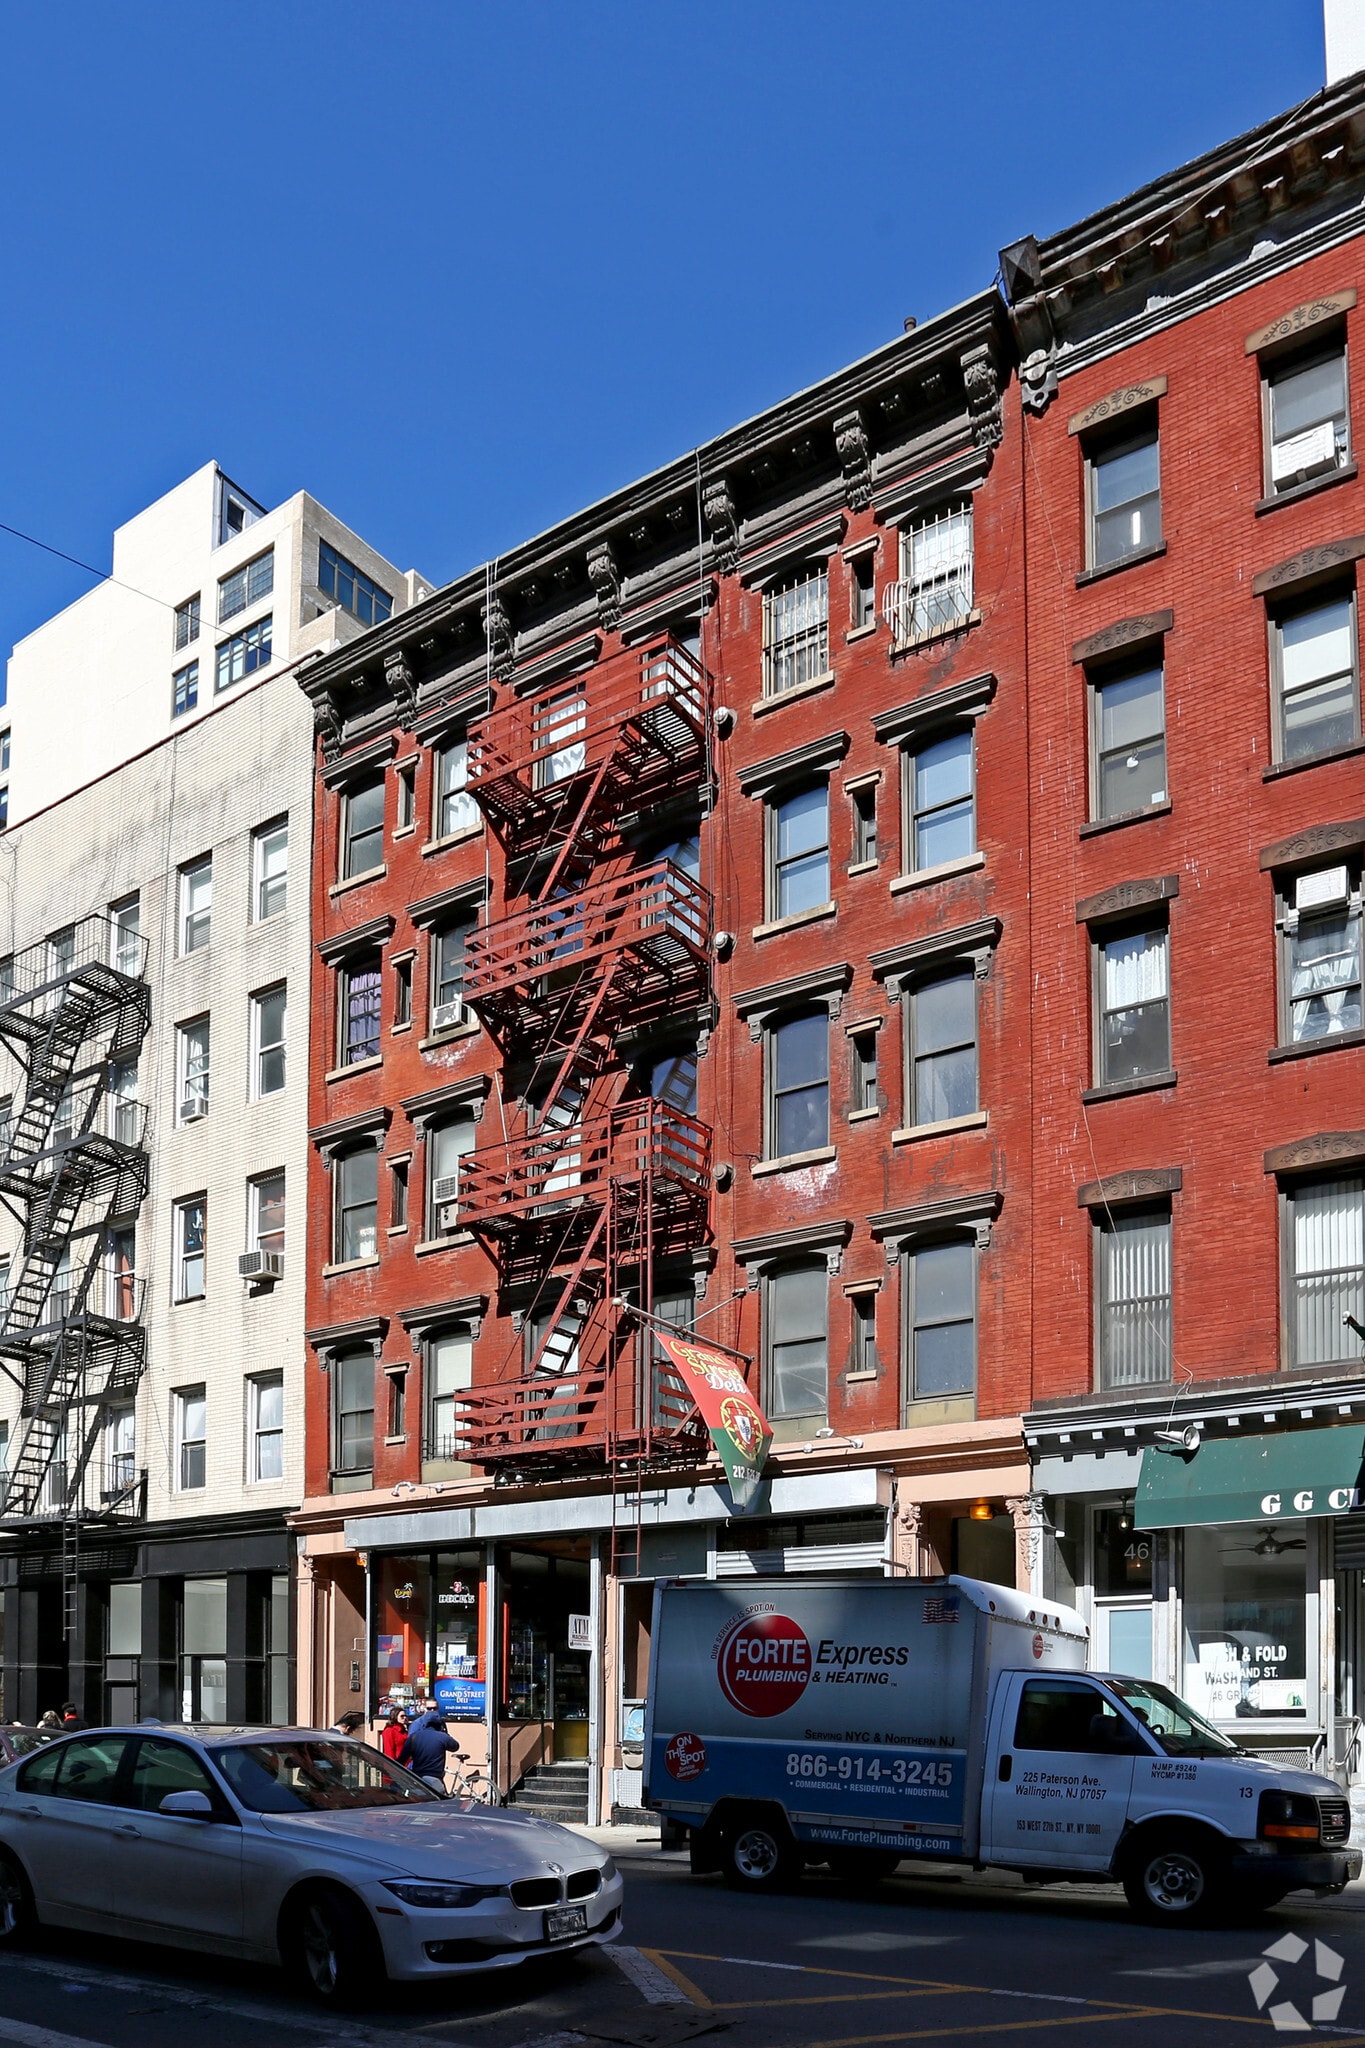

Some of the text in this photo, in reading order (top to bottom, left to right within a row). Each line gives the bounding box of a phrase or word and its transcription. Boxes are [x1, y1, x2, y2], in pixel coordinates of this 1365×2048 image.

[670, 1341, 729, 1367] Grand
[687, 1357, 743, 1382] Street
[705, 1372, 746, 1394] Deli
[1261, 1494, 1281, 1515] G
[1294, 1491, 1314, 1512] G
[1124, 1543, 1149, 1560] 46
[573, 1618, 589, 1635] ATM
[711, 1603, 775, 1660] OUR SERVICE IS SPOT ON
[735, 1638, 909, 1670] FORTE Express
[1242, 1646, 1251, 1662] &
[1255, 1644, 1287, 1662] FOLD
[736, 1669, 808, 1682] PLUMBING
[812, 1671, 821, 1682] &
[825, 1672, 889, 1685] HEATING
[1263, 1666, 1279, 1678] ST.
[440, 1690, 485, 1699] GRAND STREET
[677, 1735, 692, 1747] ON
[804, 1729, 956, 1747] SERVING NYC & NORTHERN NJ
[667, 1747, 686, 1760] THE
[680, 1750, 705, 1765] SPOT
[786, 1753, 953, 1786] 866-914-3245
[1151, 1771, 1176, 1779] NYCMP
[1152, 1763, 1173, 1771] NJMP
[1023, 1772, 1101, 1787] 225 Paterson Ave.
[795, 1779, 950, 1798] COMMERCIAL RESIDENTIAL INDUSTRIAL
[1016, 1785, 1107, 1800] Wallington, NJ 07057
[1239, 1787, 1253, 1798] 13
[1027, 1820, 1041, 1831] WEST
[1077, 1823, 1085, 1834] NY
[810, 1828, 950, 1850] www.FortePlumbing.com
